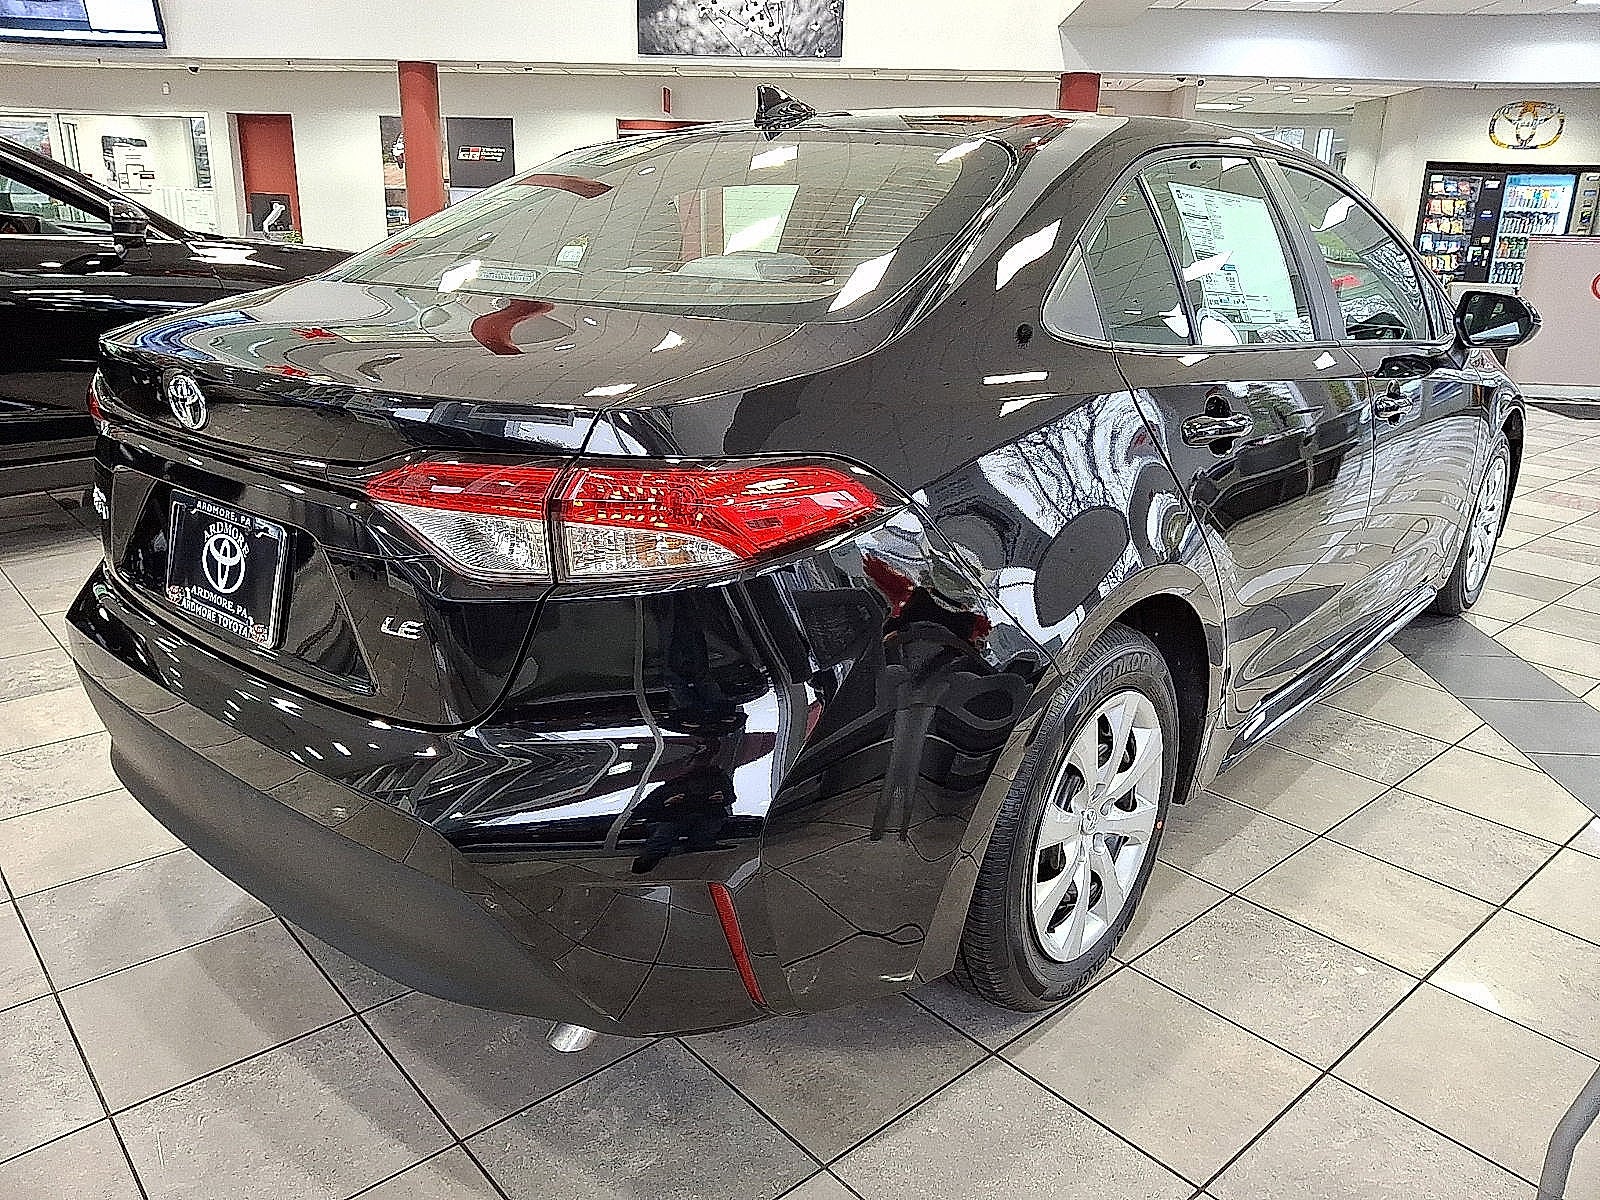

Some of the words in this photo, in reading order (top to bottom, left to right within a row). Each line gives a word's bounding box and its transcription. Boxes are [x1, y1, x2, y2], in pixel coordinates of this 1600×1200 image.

[196, 500, 238, 522] ARDMORE,
[240, 515, 252, 527] PA
[203, 521, 250, 558] ARDMORE
[180, 597, 217, 622] ARDMORE
[217, 613, 250, 638] TOYOTA
[236, 604, 249, 619] PA
[380, 616, 424, 640] LE
